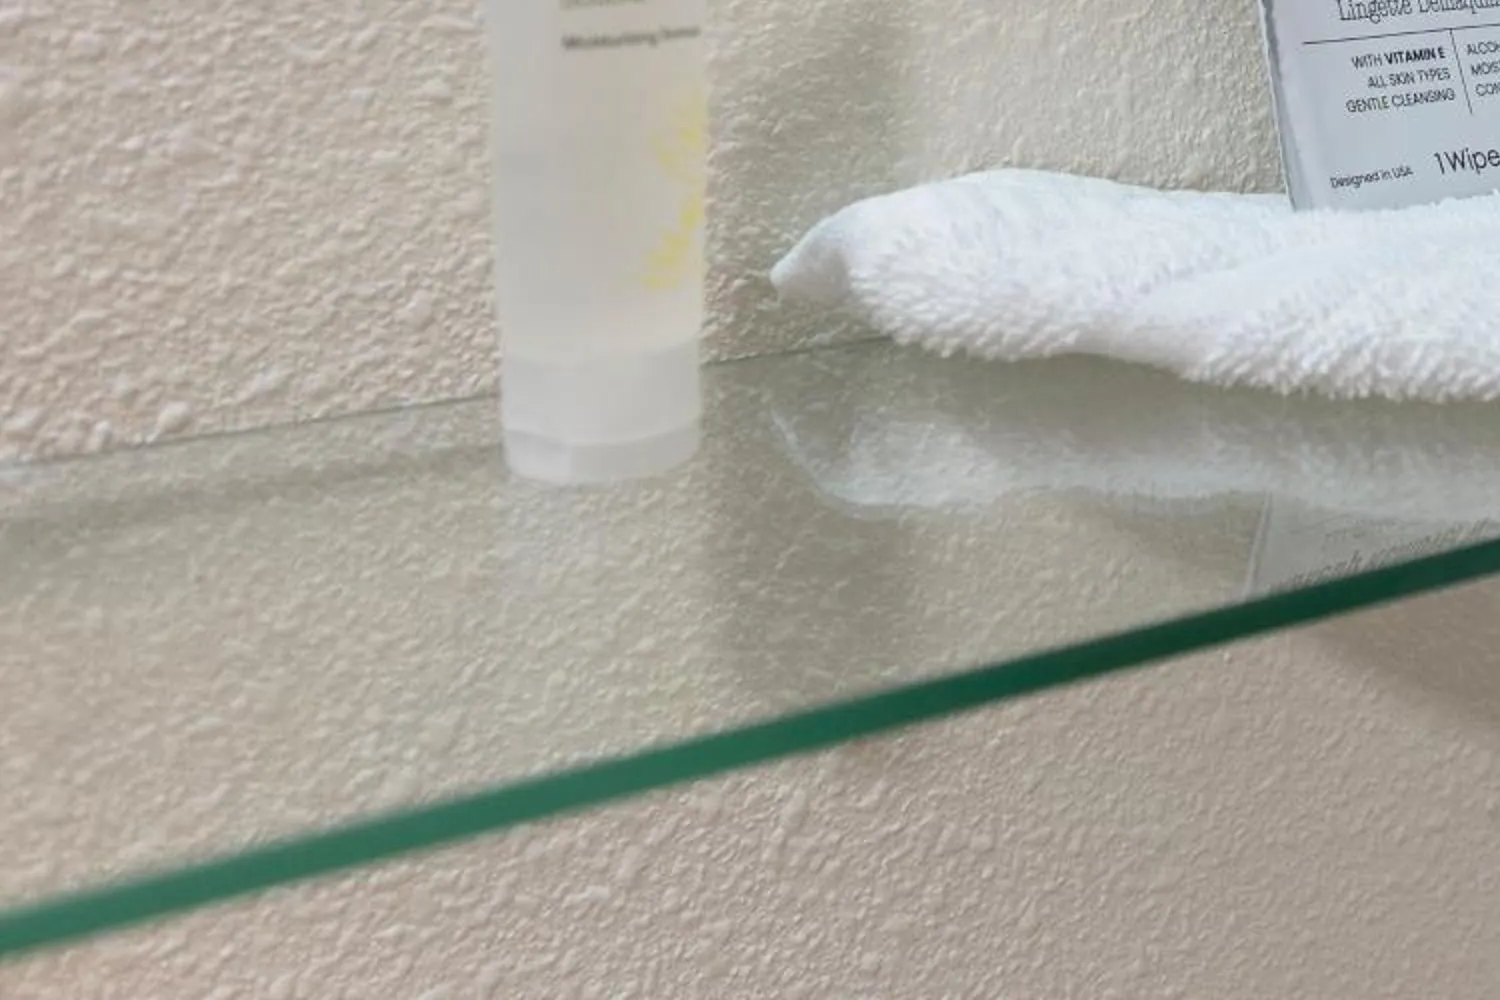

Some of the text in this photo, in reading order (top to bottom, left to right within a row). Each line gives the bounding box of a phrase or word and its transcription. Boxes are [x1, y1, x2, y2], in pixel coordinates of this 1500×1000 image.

[1351, 47, 1446, 69] WITH VITAMIN E
[1367, 67, 1451, 88] ALL SKIN TYPES
[1345, 87, 1455, 112] GENTLE CLEANSING
[1329, 171, 1380, 188] Designed
[1392, 164, 1414, 178] USA
